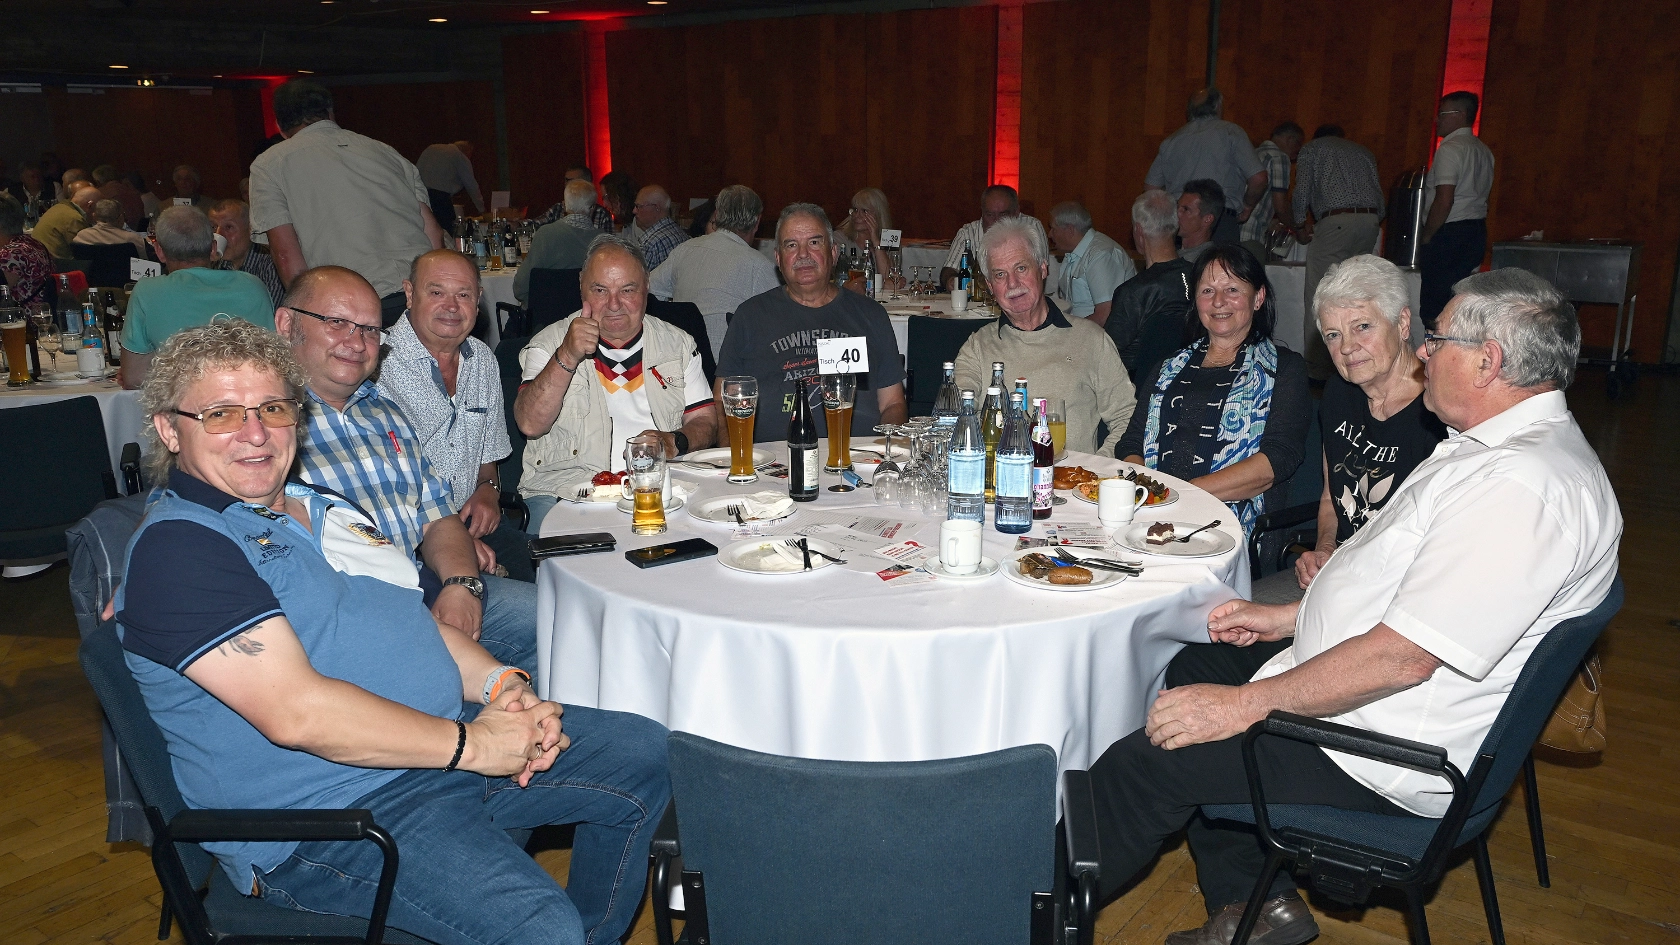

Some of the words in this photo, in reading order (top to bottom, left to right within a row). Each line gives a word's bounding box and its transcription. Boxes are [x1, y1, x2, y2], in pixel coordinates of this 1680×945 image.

[145, 267, 156, 278] 41
[841, 348, 861, 364] 40
[783, 367, 820, 382] ARIZ
[1362, 440, 1399, 463] THE
